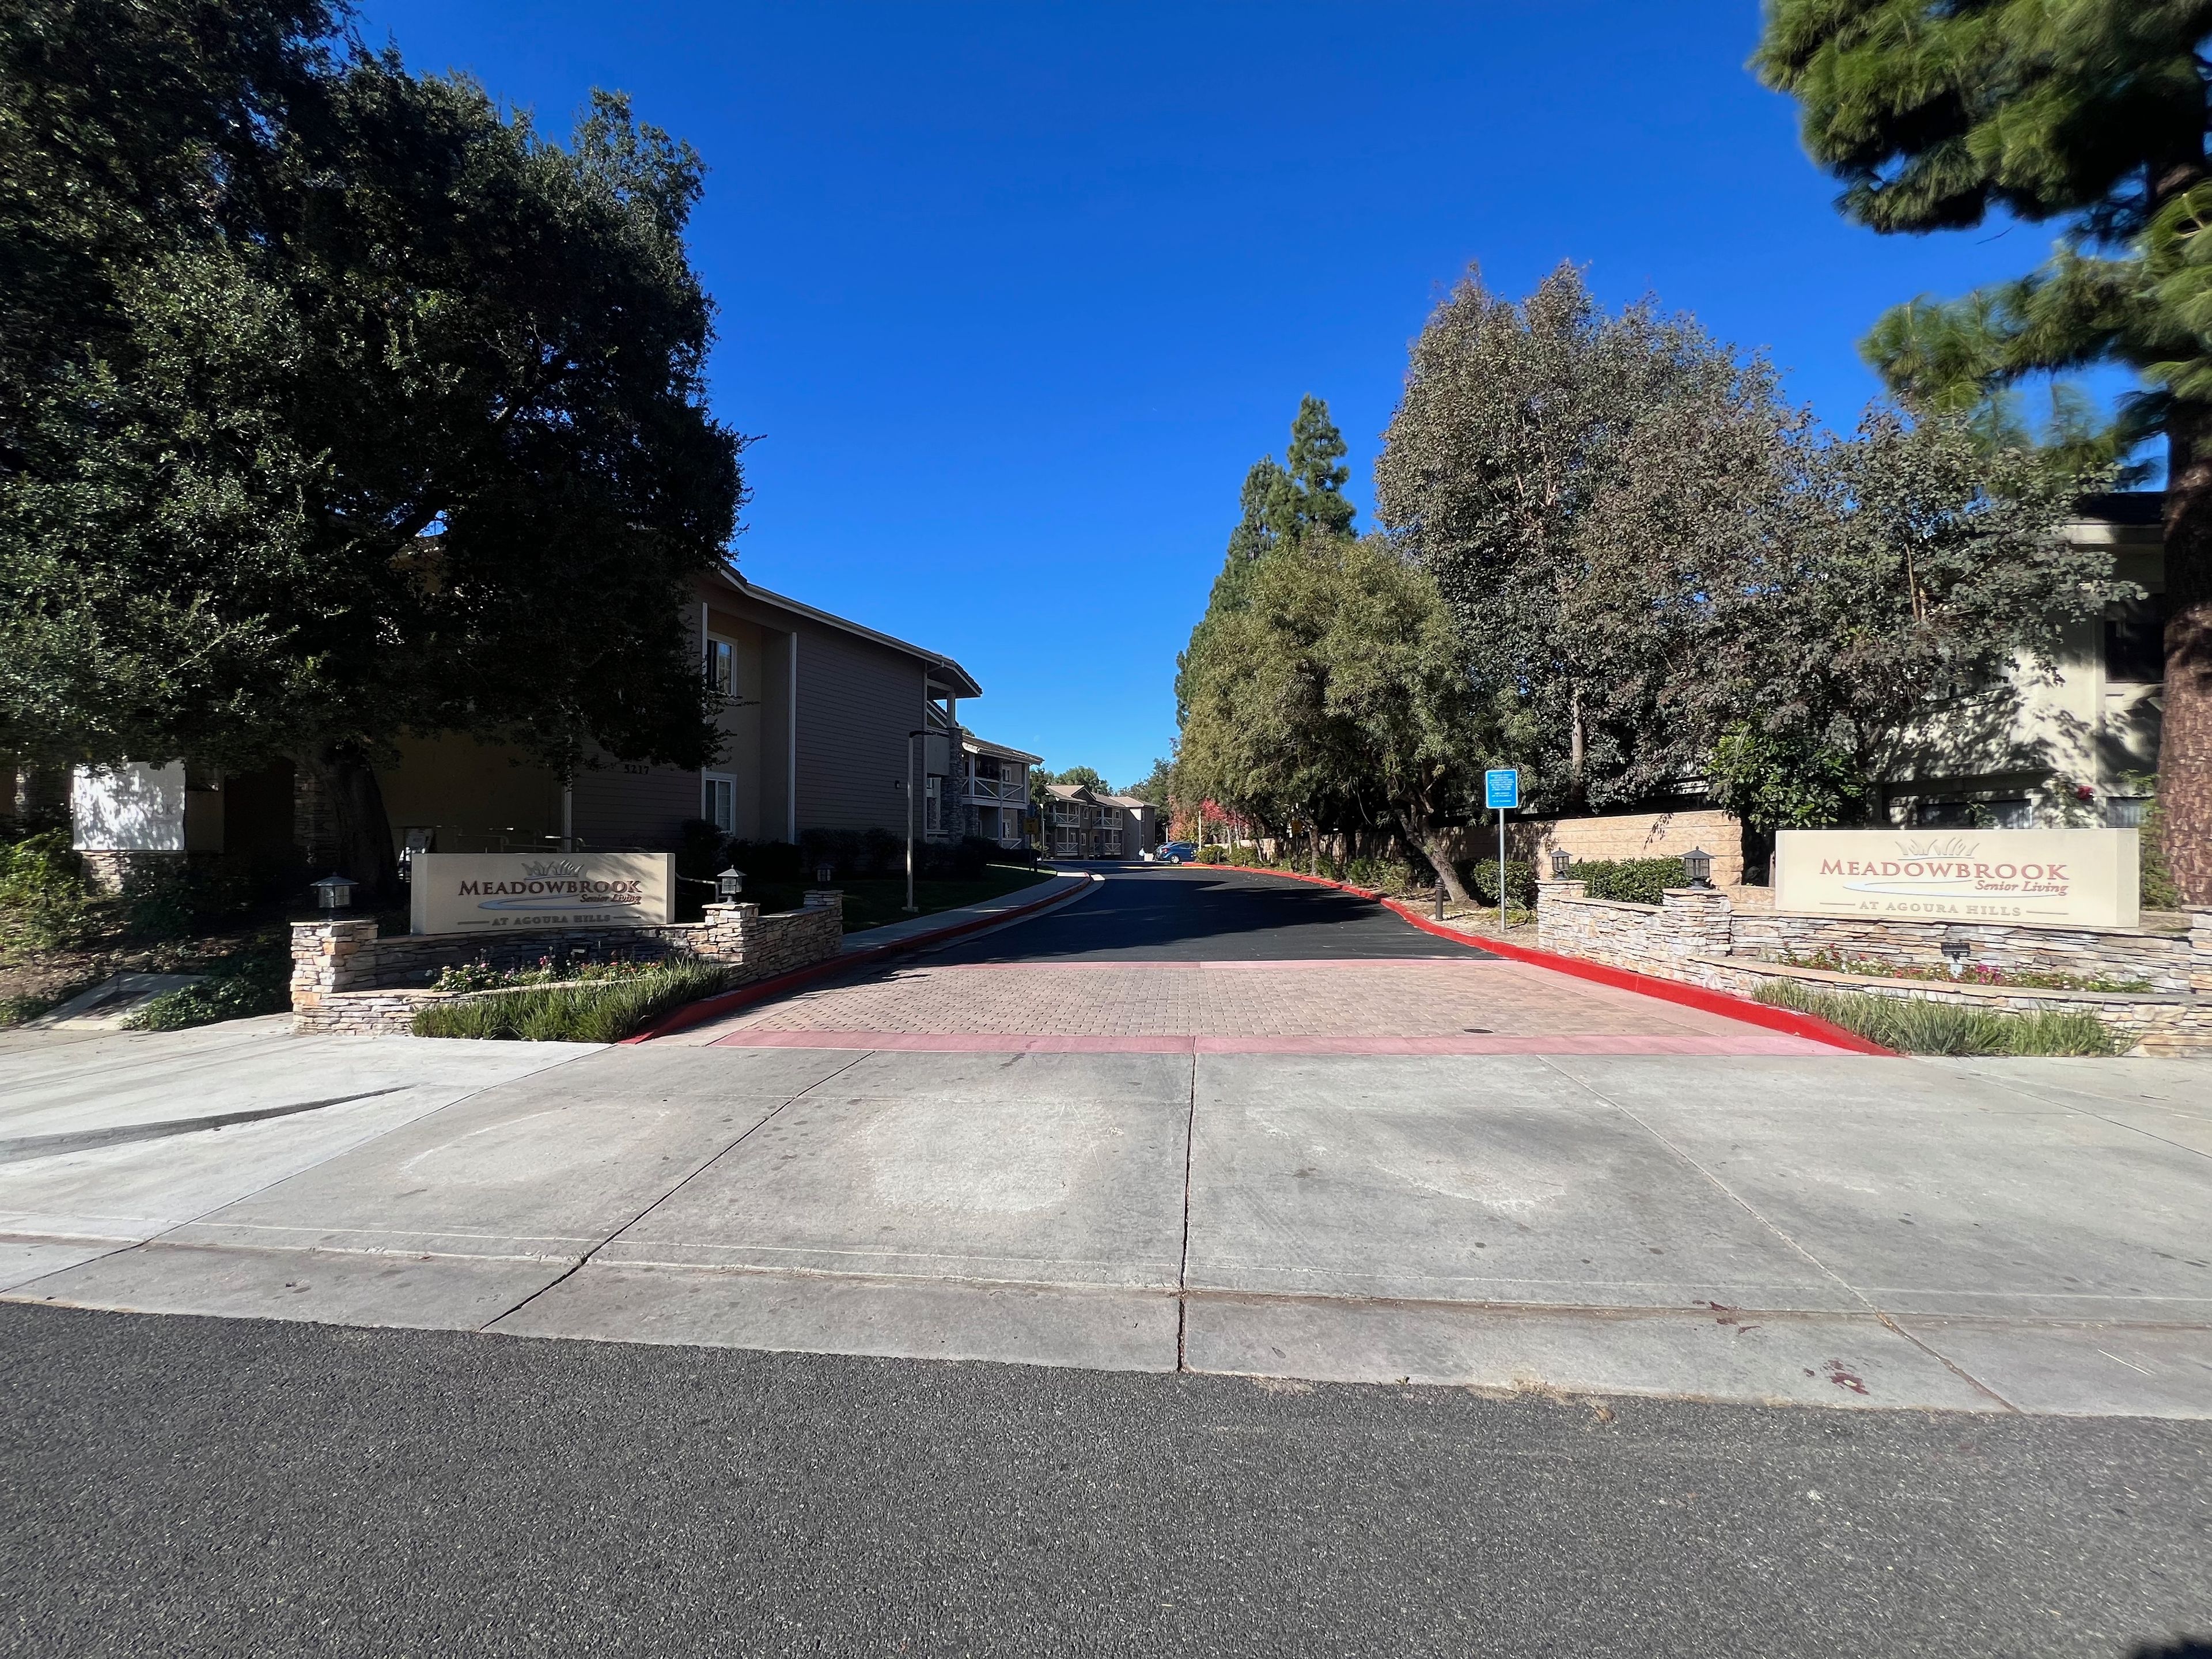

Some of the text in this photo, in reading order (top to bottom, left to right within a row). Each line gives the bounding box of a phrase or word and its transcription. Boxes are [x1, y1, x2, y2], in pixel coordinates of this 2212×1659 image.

[624, 764, 649, 775] 5217
[1820, 859, 2069, 880] MEADOWBROOK
[459, 880, 642, 896] MEADOWBROOK
[1975, 880, 2069, 896] Senior Living
[579, 893, 642, 904] Senior Living
[1859, 902, 2021, 916] AT AGOURA HILLS
[492, 914, 611, 926] AT AGOURA HILLS
